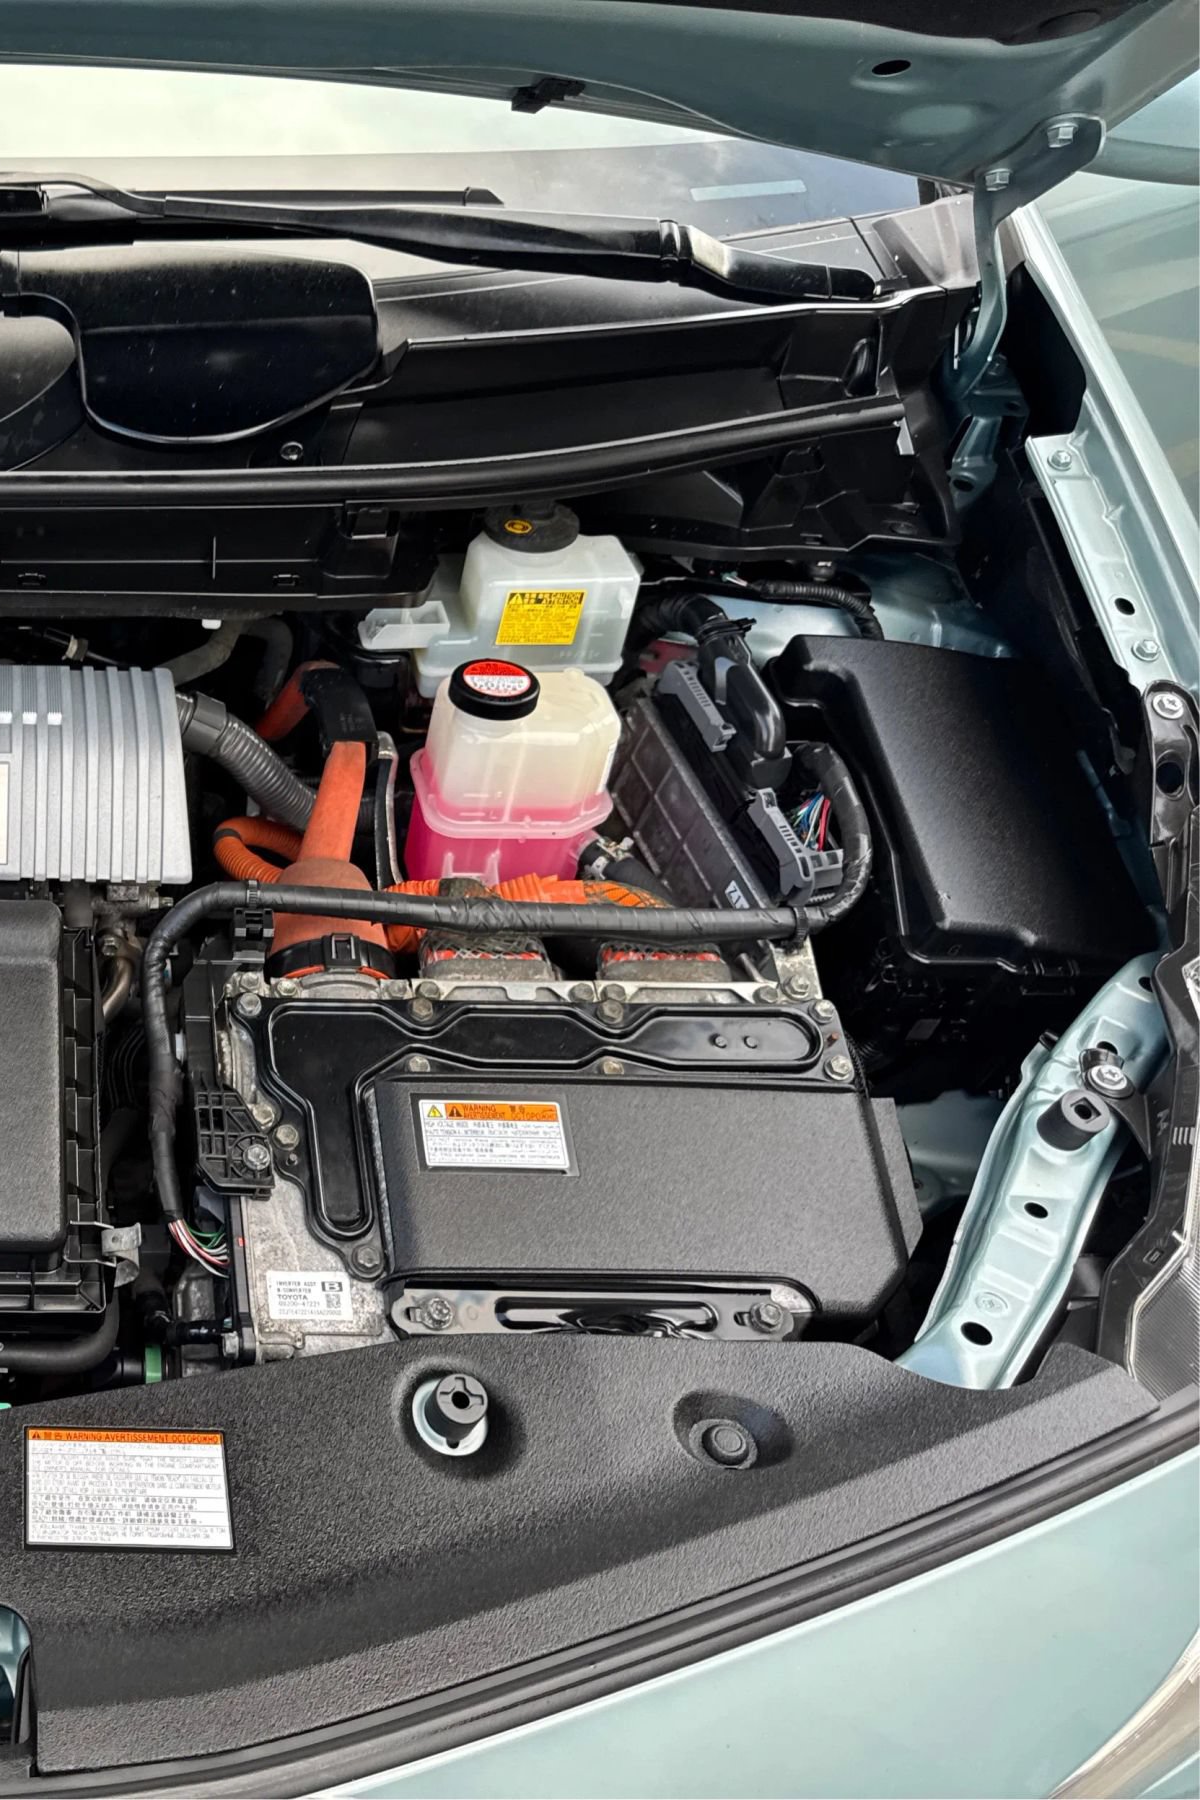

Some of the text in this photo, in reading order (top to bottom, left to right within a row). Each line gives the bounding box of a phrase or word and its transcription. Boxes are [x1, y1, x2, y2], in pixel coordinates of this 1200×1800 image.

[463, 1105, 497, 1113] WARNING
[66, 1432, 102, 1441] WARNING
[104, 1433, 170, 1443] AVERTISSEMENT
